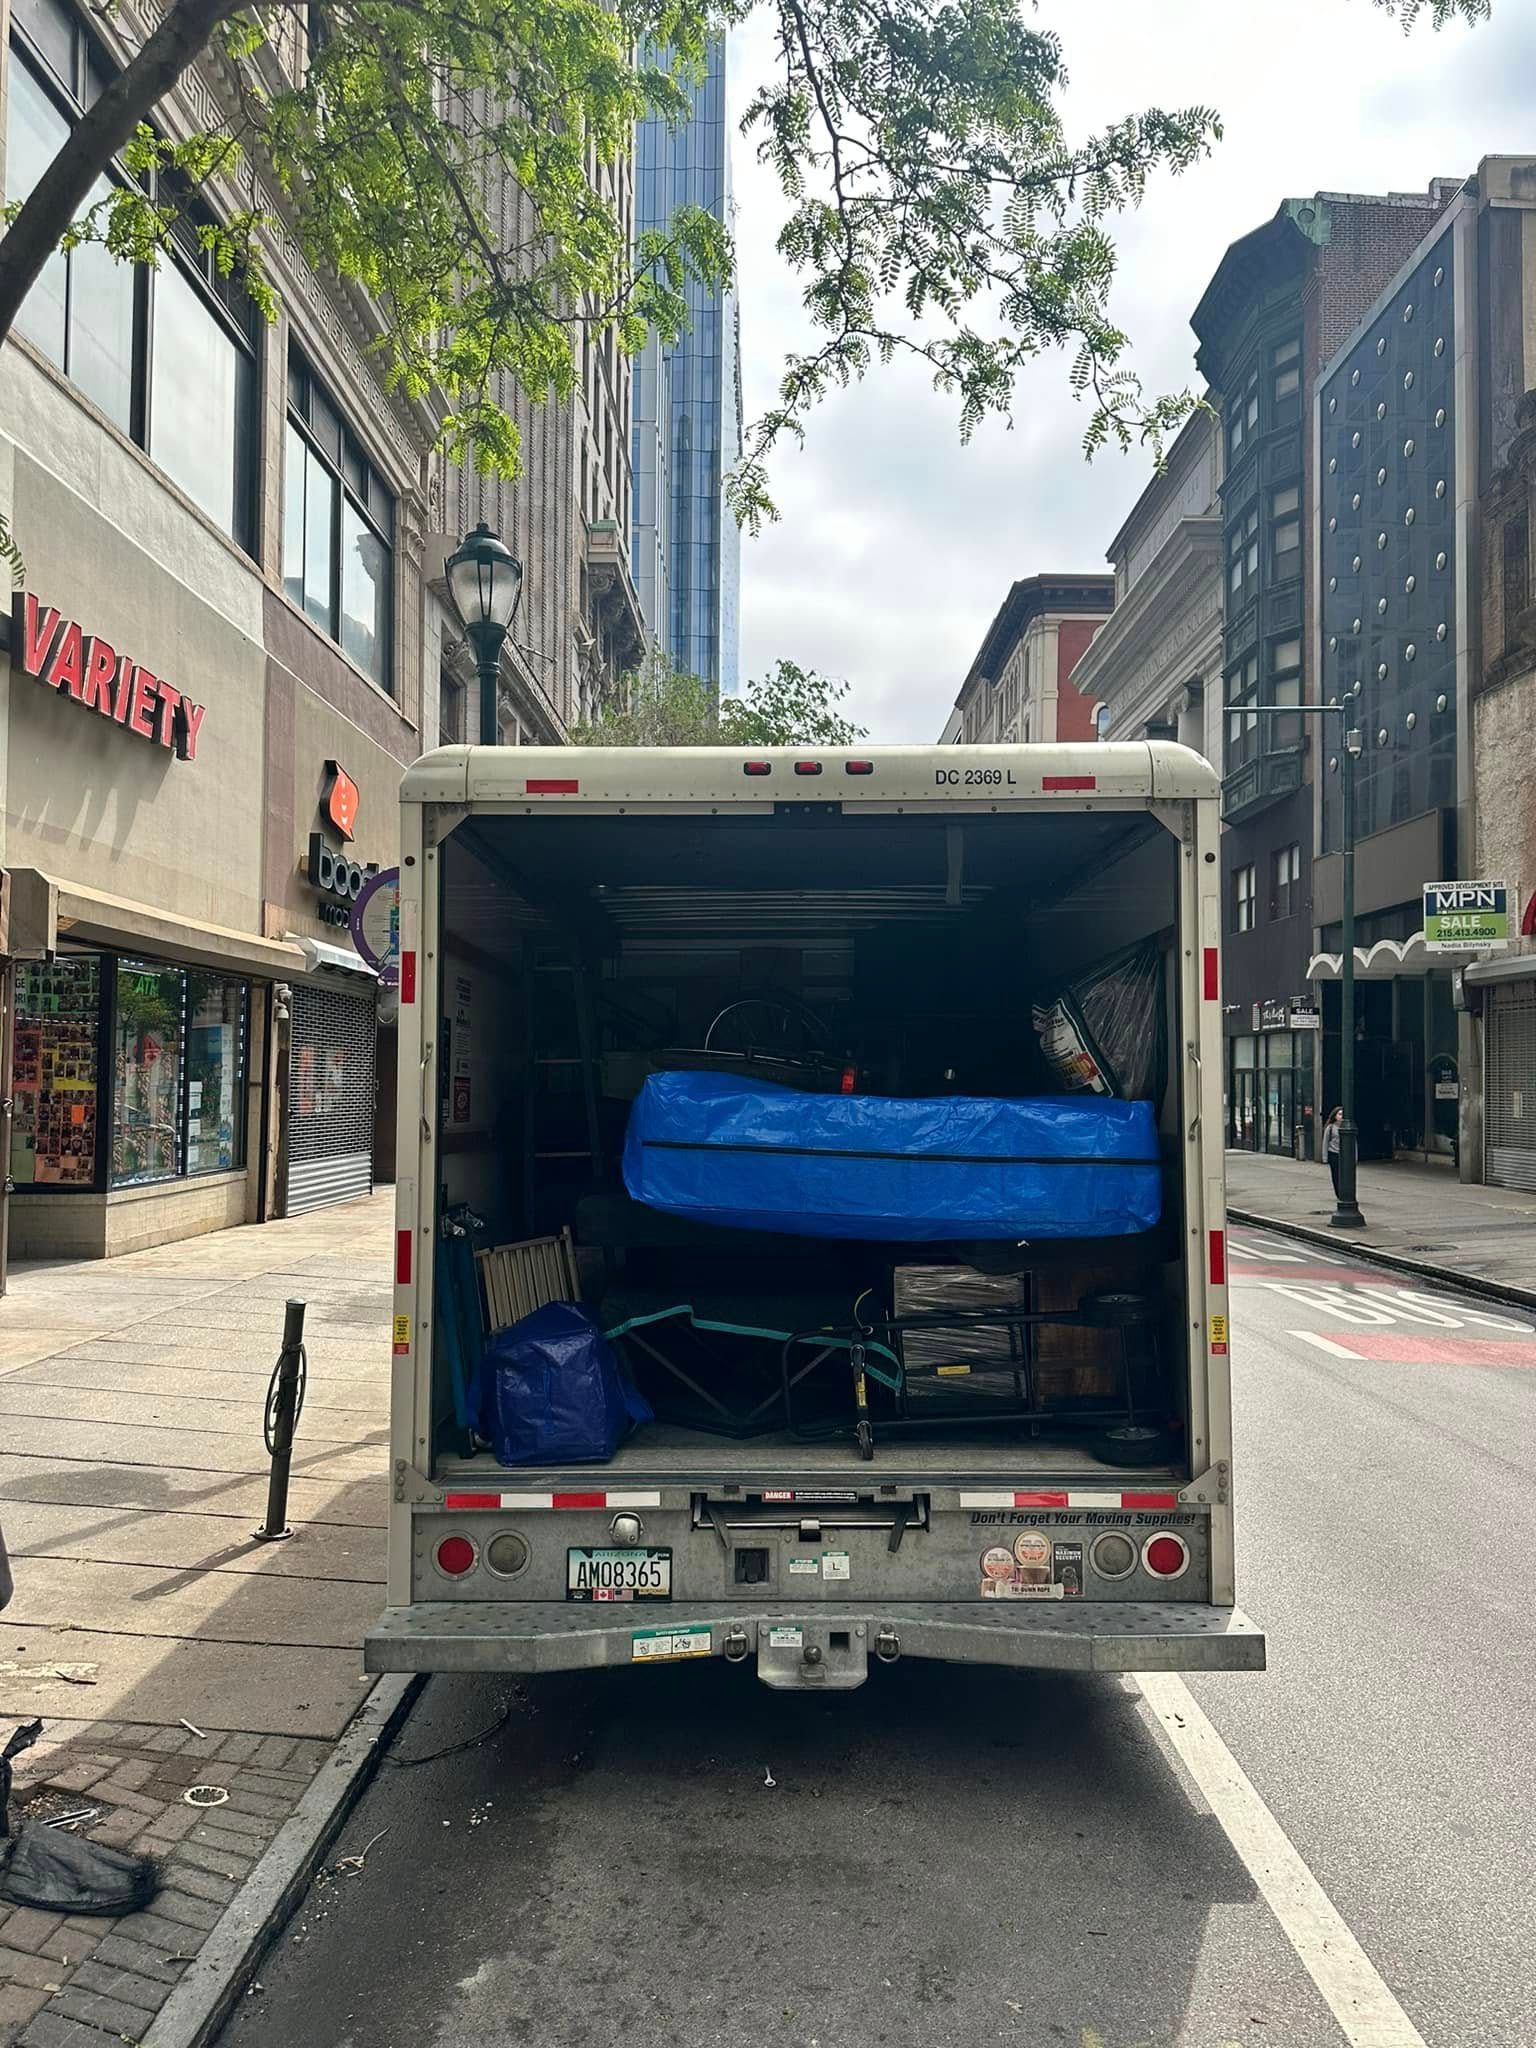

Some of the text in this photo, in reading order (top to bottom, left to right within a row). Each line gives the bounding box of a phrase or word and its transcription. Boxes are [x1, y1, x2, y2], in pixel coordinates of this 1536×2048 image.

[18, 591, 207, 760] VARIETY
[935, 768, 1017, 785] DC 2369 L
[309, 833, 378, 901] boo
[1428, 881, 1504, 891] APPROVED DEVELOPMENT SITE
[1436, 890, 1496, 908] MPN
[1440, 916, 1481, 929] SALE
[1436, 927, 1497, 938] 215.413.4900
[1258, 1282, 1536, 1334] BUS
[765, 1491, 791, 1500] DANGER
[971, 1512, 1196, 1527] Don't Forget Your Moving Supplies!
[577, 1561, 661, 1588] AM08365
